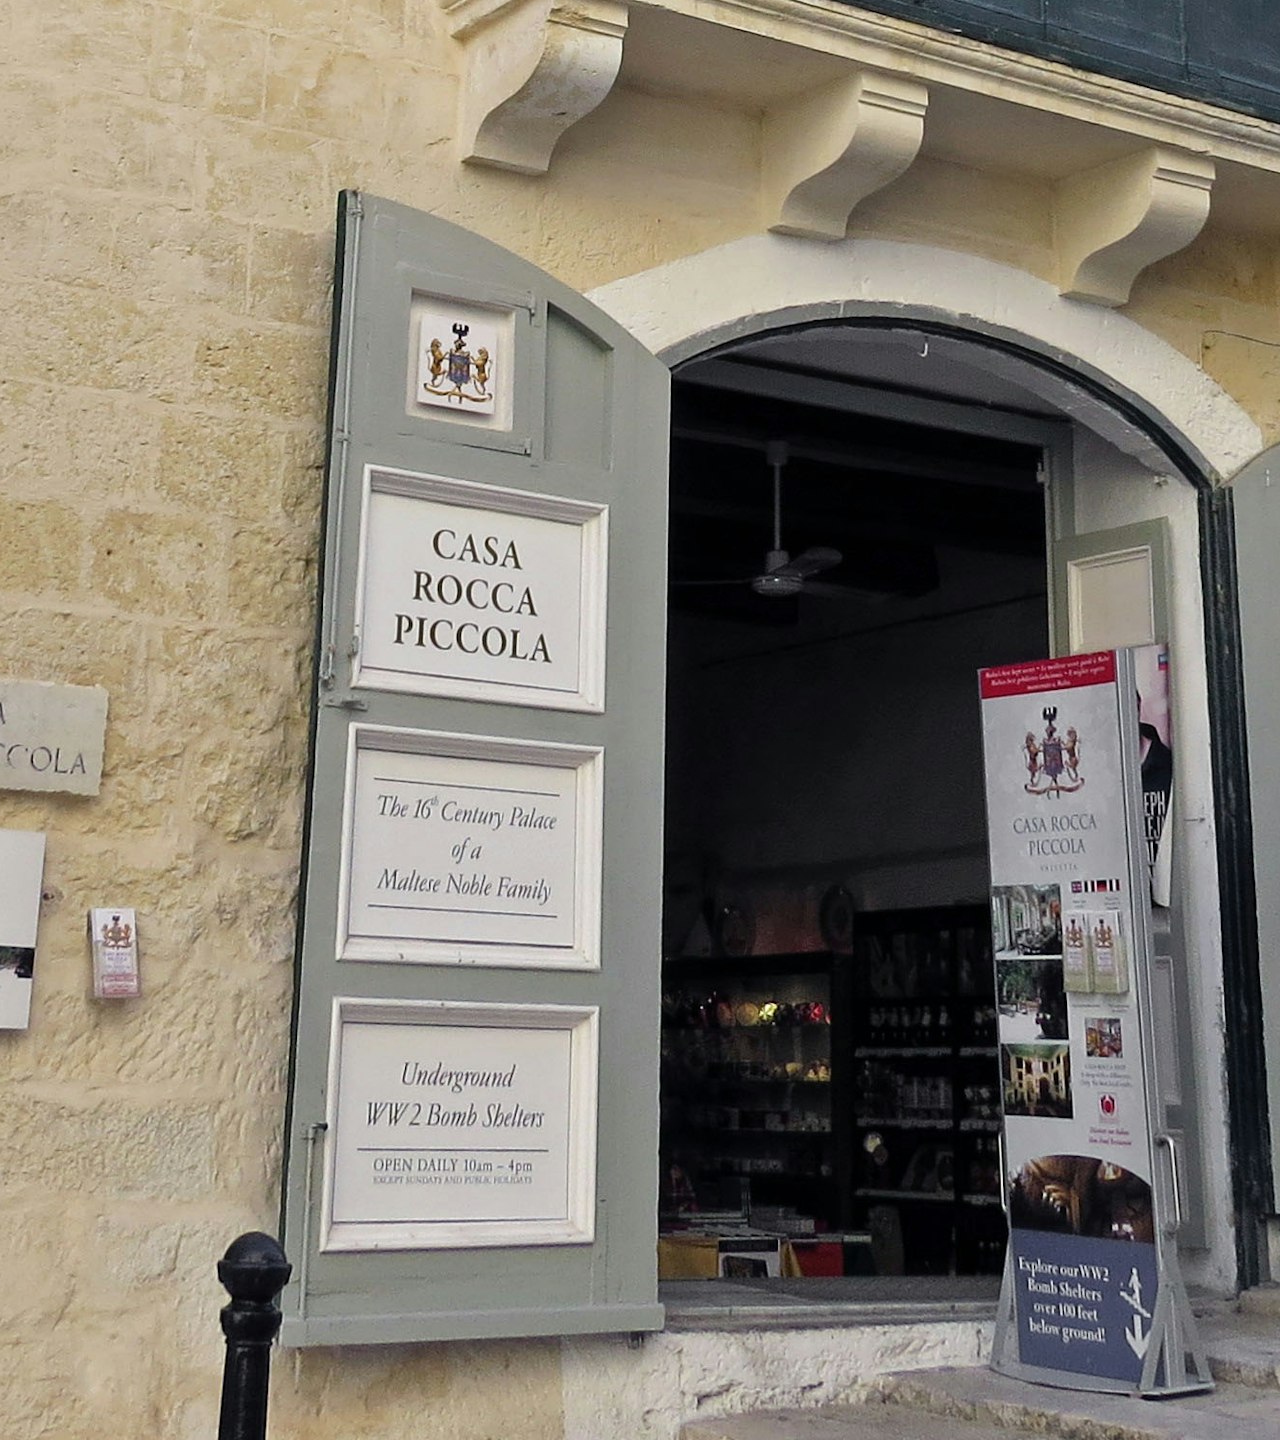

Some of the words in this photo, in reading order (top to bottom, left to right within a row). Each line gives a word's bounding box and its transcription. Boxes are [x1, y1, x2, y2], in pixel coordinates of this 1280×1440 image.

[432, 529, 523, 570] CASA
[412, 570, 538, 617] ROCCA
[393, 613, 552, 664] PICCOLA
[377, 794, 409, 818] The
[413, 795, 439, 819] 16th
[441, 801, 504, 831] Century
[509, 806, 557, 830] Palace
[1144, 790, 1165, 816] EPH
[1013, 816, 1047, 834] CASA
[1051, 813, 1098, 831] ROCCA
[451, 837, 471, 864] of
[471, 845, 482, 860] a
[1029, 838, 1086, 856] PICCOLA
[377, 868, 441, 894] Maltese
[446, 872, 492, 896] Noble
[497, 876, 552, 906] Family
[402, 1061, 516, 1093] Underground
[427, 1103, 478, 1127] Bomb
[482, 1103, 545, 1128] Shelters
[373, 1159, 412, 1172] OPEN
[417, 1159, 458, 1172] DAILY
[464, 1159, 493, 1172] 10am
[508, 1159, 532, 1175] 4pm
[1018, 1256, 1058, 1277] Explore
[1060, 1266, 1079, 1277] our
[1079, 1264, 1109, 1282] WW2
[1027, 1277, 1058, 1295] Bomb
[1059, 1282, 1102, 1302] Shelters
[1033, 1303, 1056, 1315] over
[1059, 1303, 1075, 1318] 100
[1078, 1304, 1098, 1321] feet
[1029, 1317, 1060, 1335] below
[1062, 1327, 1106, 1343] ground!
